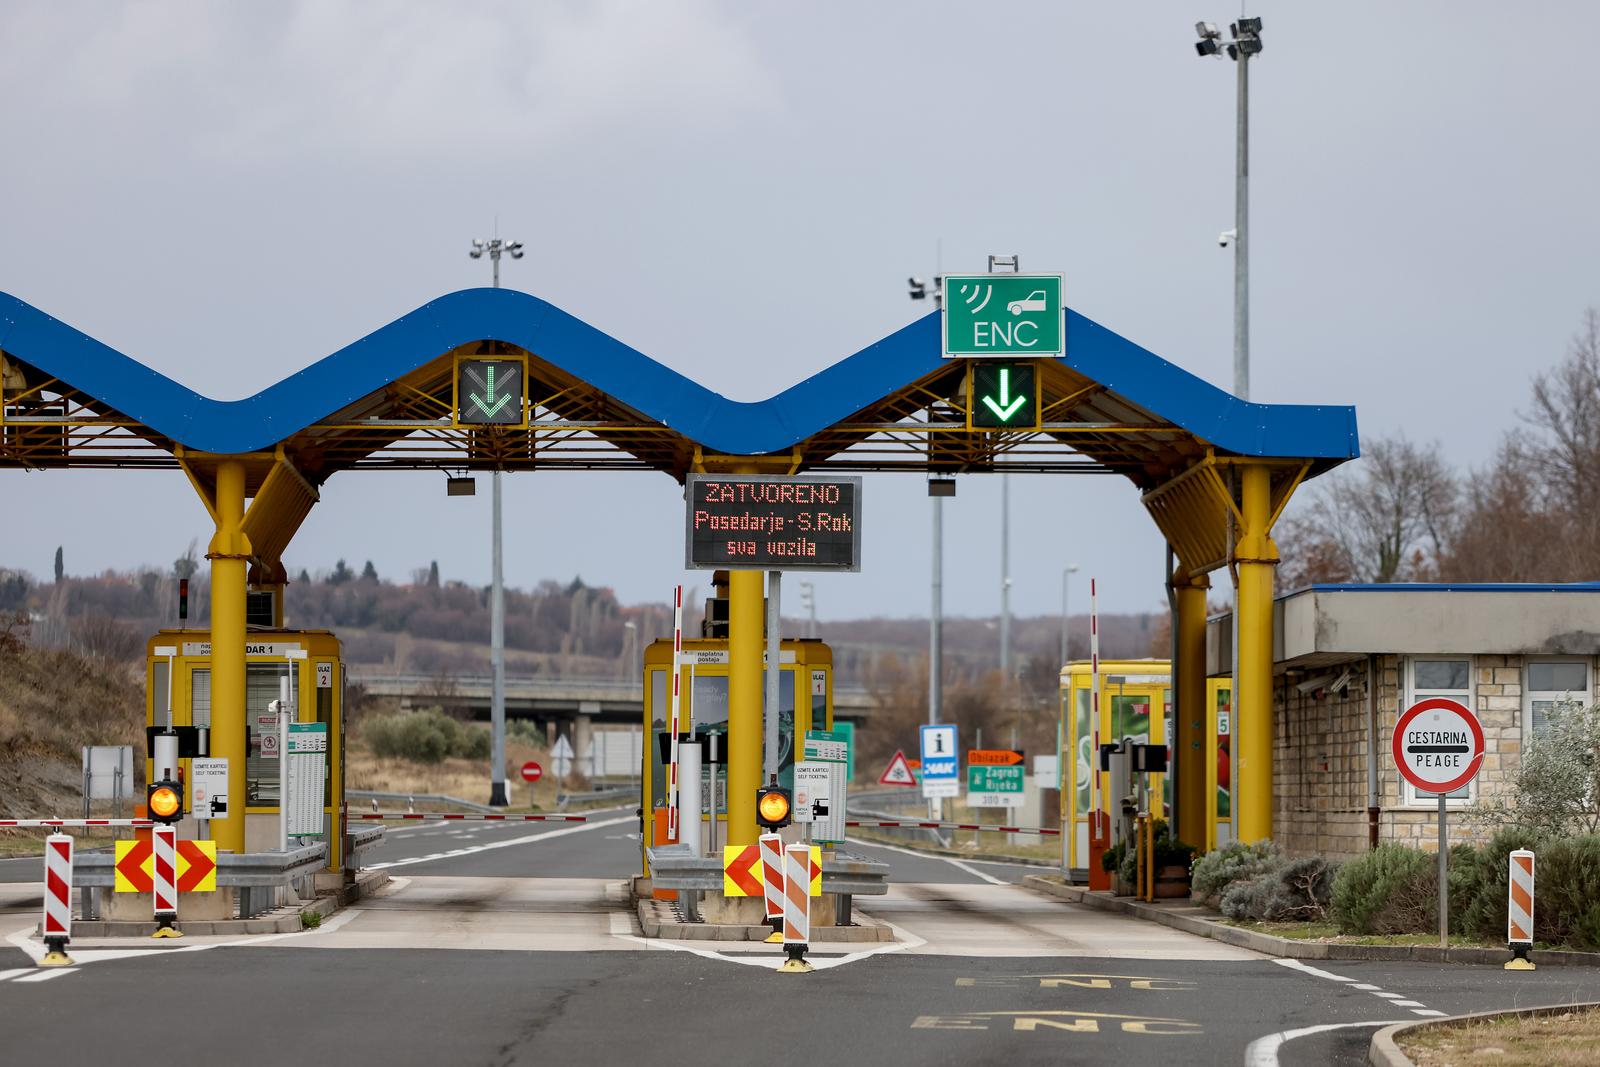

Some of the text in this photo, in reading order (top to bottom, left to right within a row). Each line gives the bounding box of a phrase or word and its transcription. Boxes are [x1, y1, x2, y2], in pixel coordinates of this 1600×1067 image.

[974, 320, 1038, 347] ENC
[705, 483, 840, 504] ZATVORENO
[727, 538, 816, 556] sva vozila
[268, 645, 273, 654] 1
[321, 675, 327, 686] 2
[816, 684, 821, 693] 1
[1219, 719, 1228, 733] 5
[1408, 731, 1468, 744] CESTARINA
[1416, 755, 1460, 767] PEAGE
[985, 767, 1019, 780] Zagreb
